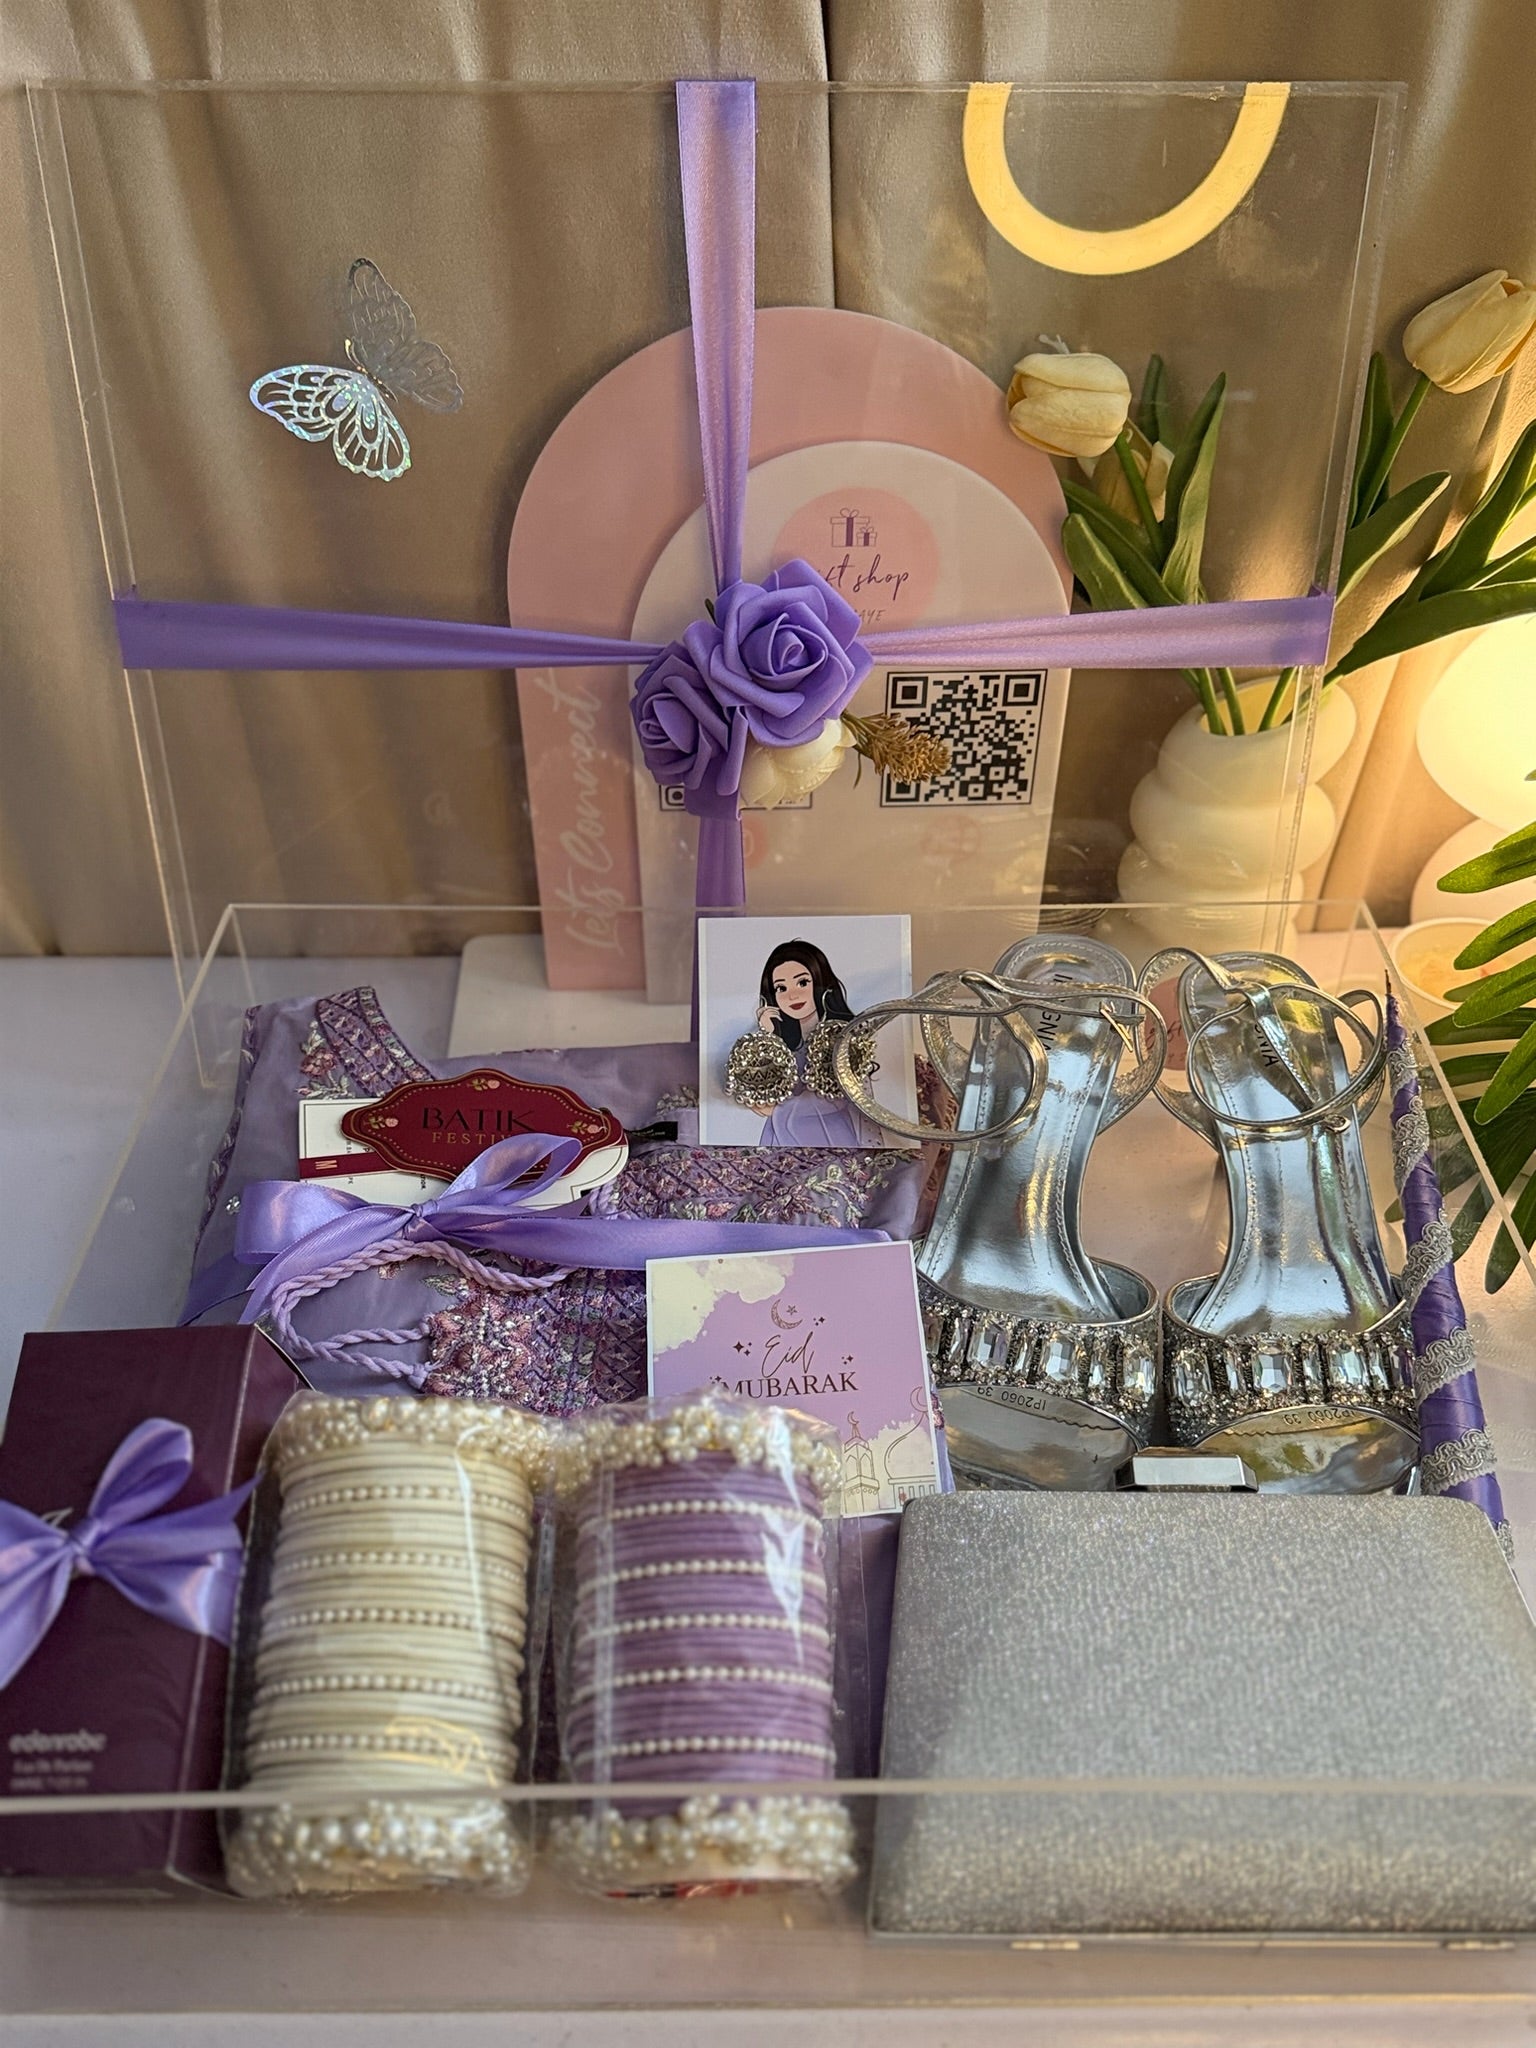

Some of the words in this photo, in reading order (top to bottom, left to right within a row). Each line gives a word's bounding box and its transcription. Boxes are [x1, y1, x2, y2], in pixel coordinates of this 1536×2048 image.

[853, 553, 909, 601] shop
[534, 666, 614, 873] Connect
[422, 1107, 536, 1132] BATIK
[761, 1331, 815, 1379] Eid
[1001, 1390, 1047, 1411] IP2060
